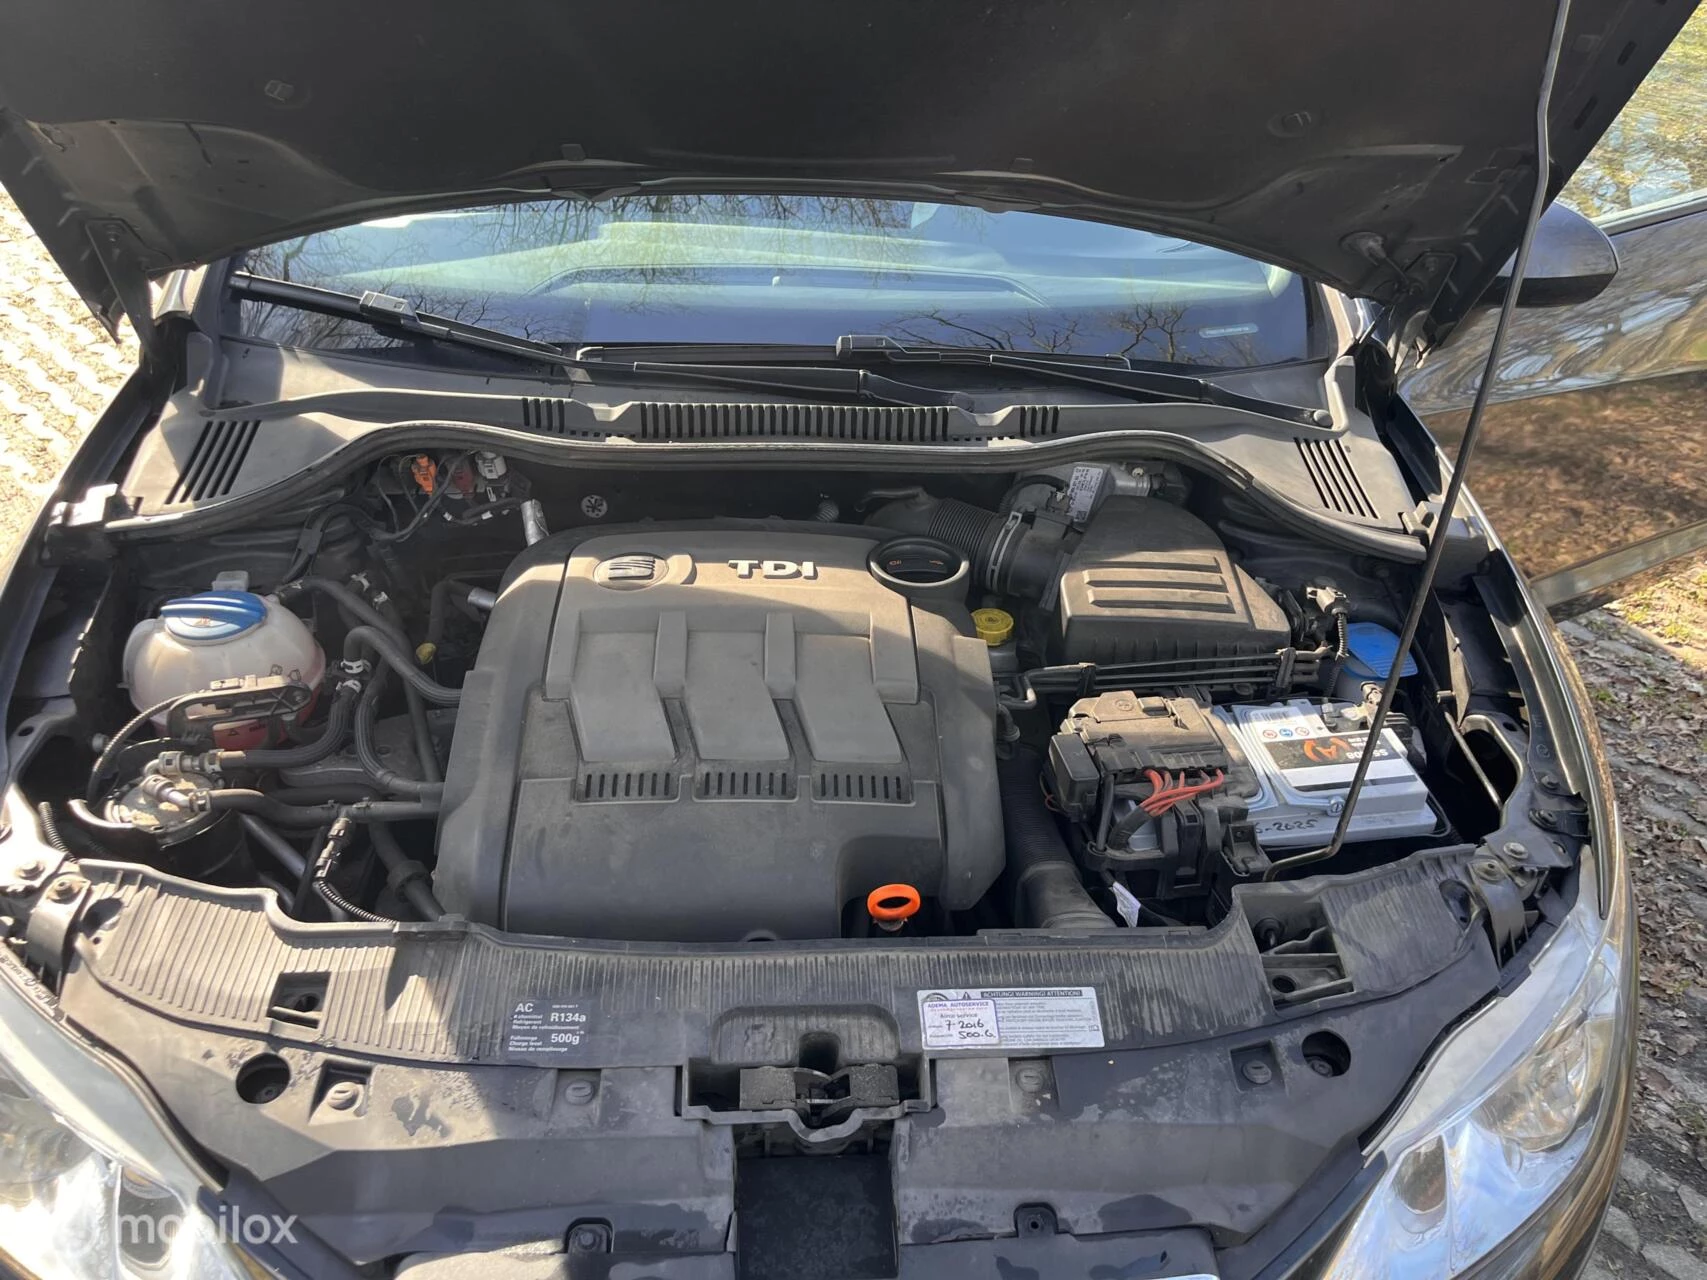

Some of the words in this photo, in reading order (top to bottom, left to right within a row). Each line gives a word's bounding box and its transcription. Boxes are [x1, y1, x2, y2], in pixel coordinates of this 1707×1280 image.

[728, 559, 816, 579] TDI
[515, 1003, 534, 1012] AC
[550, 1012, 587, 1022] R134a
[551, 1033, 580, 1045] 500g
